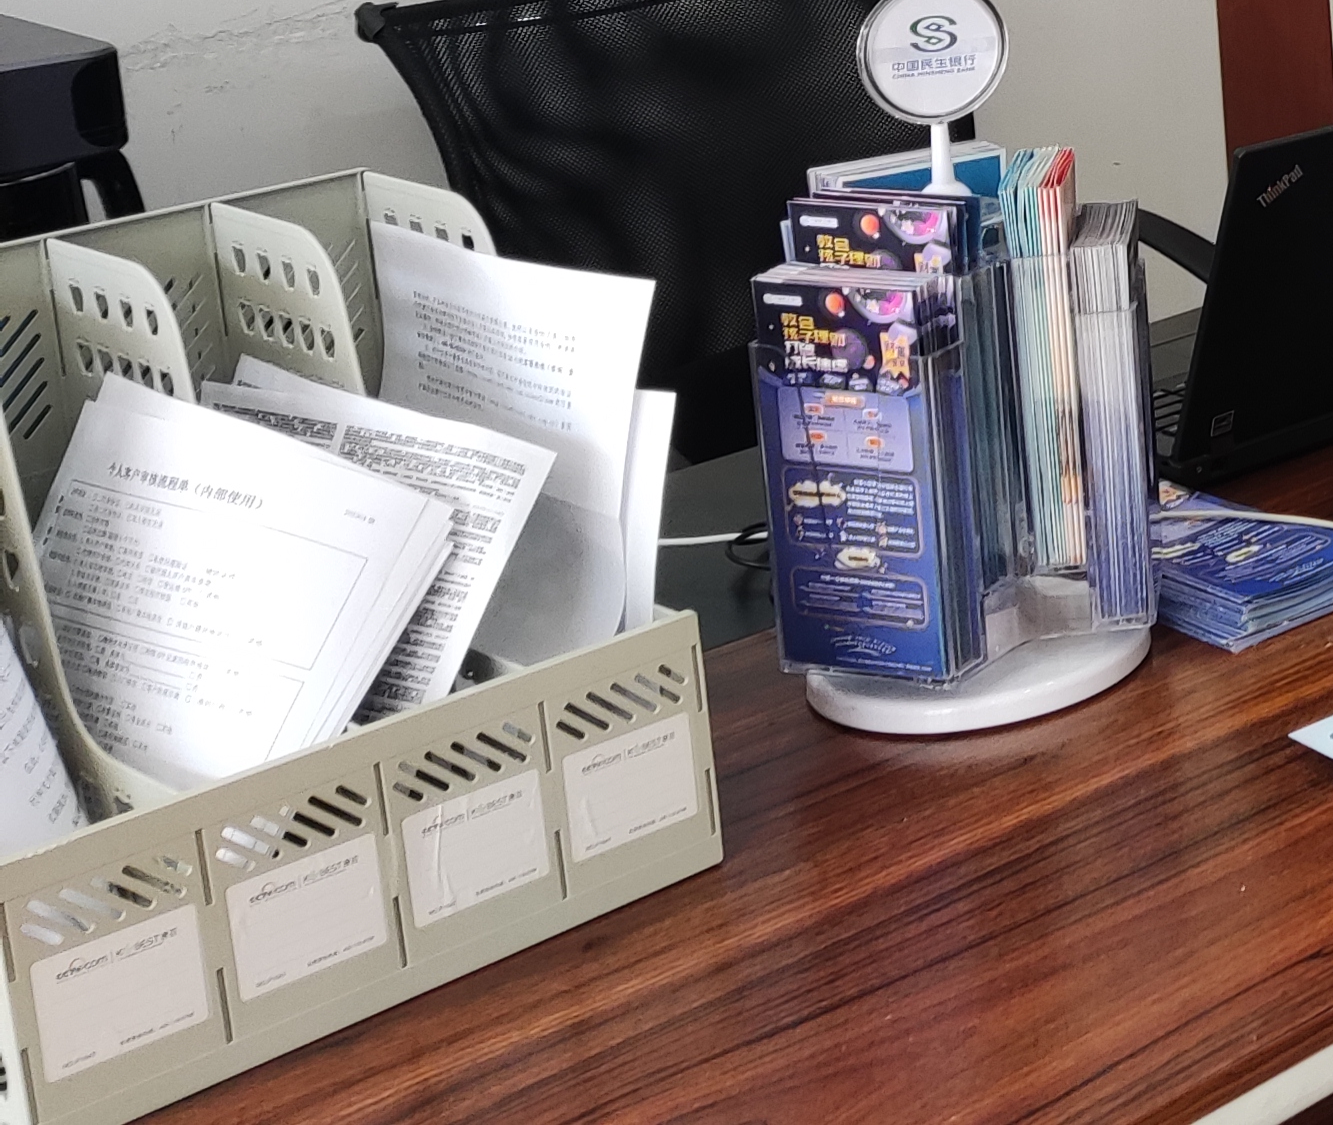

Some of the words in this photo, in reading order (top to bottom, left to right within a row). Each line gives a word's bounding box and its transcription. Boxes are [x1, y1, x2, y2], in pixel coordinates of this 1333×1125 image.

[892, 54, 977, 73] 中国民生银行
[1256, 164, 1303, 208] ThinkPad
